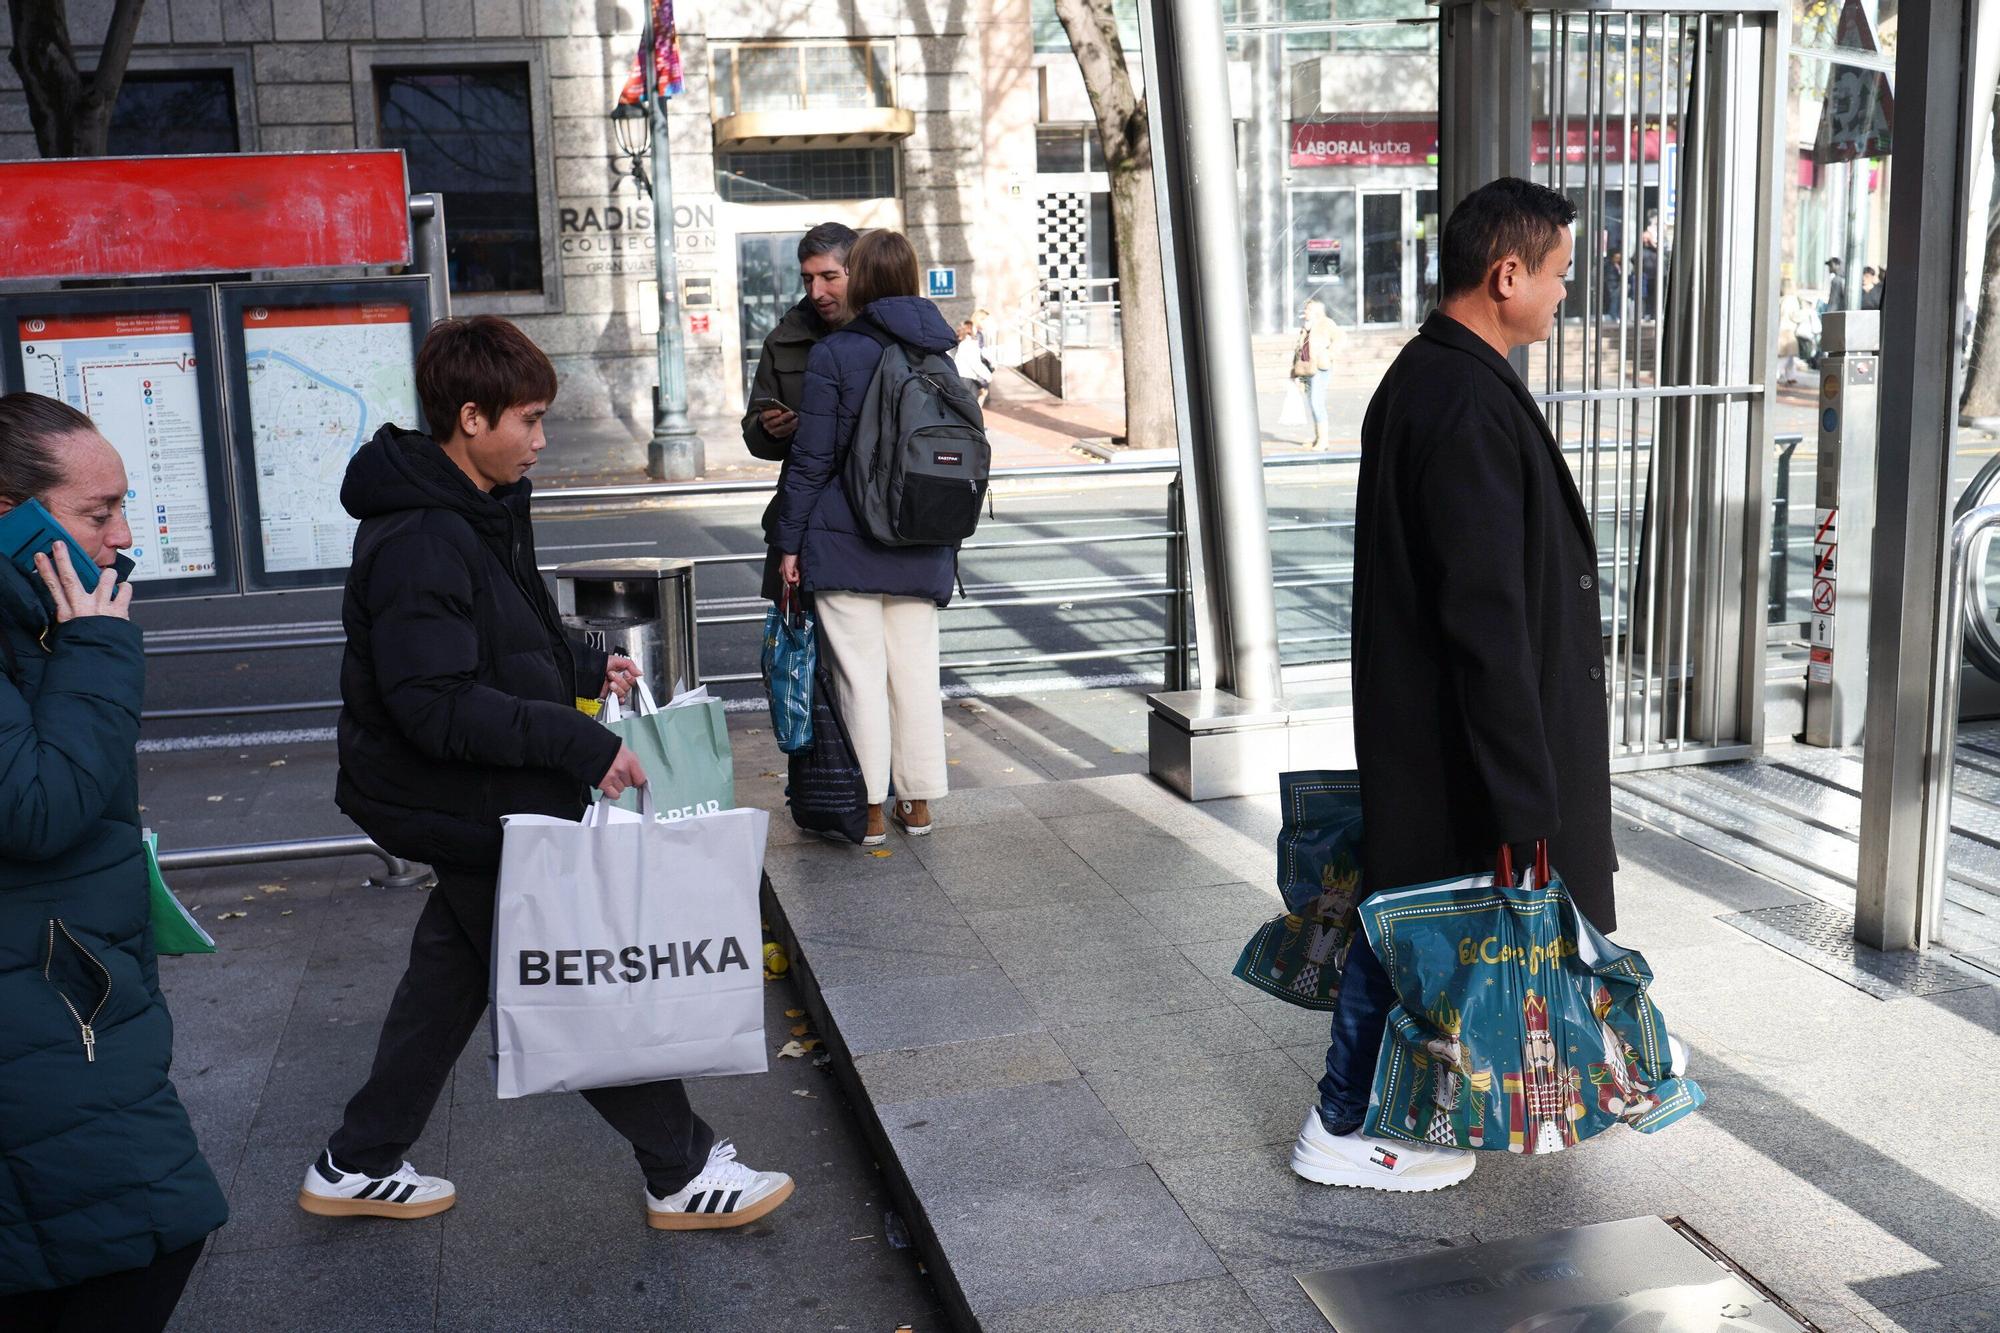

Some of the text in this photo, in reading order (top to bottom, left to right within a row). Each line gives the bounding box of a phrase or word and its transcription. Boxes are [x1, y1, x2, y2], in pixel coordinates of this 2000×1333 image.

[1297, 140, 1411, 154] LABORAL kutxa
[560, 204, 714, 233] RADISON
[562, 235, 716, 253] COLLECION
[519, 936, 750, 986] BERSHKA
